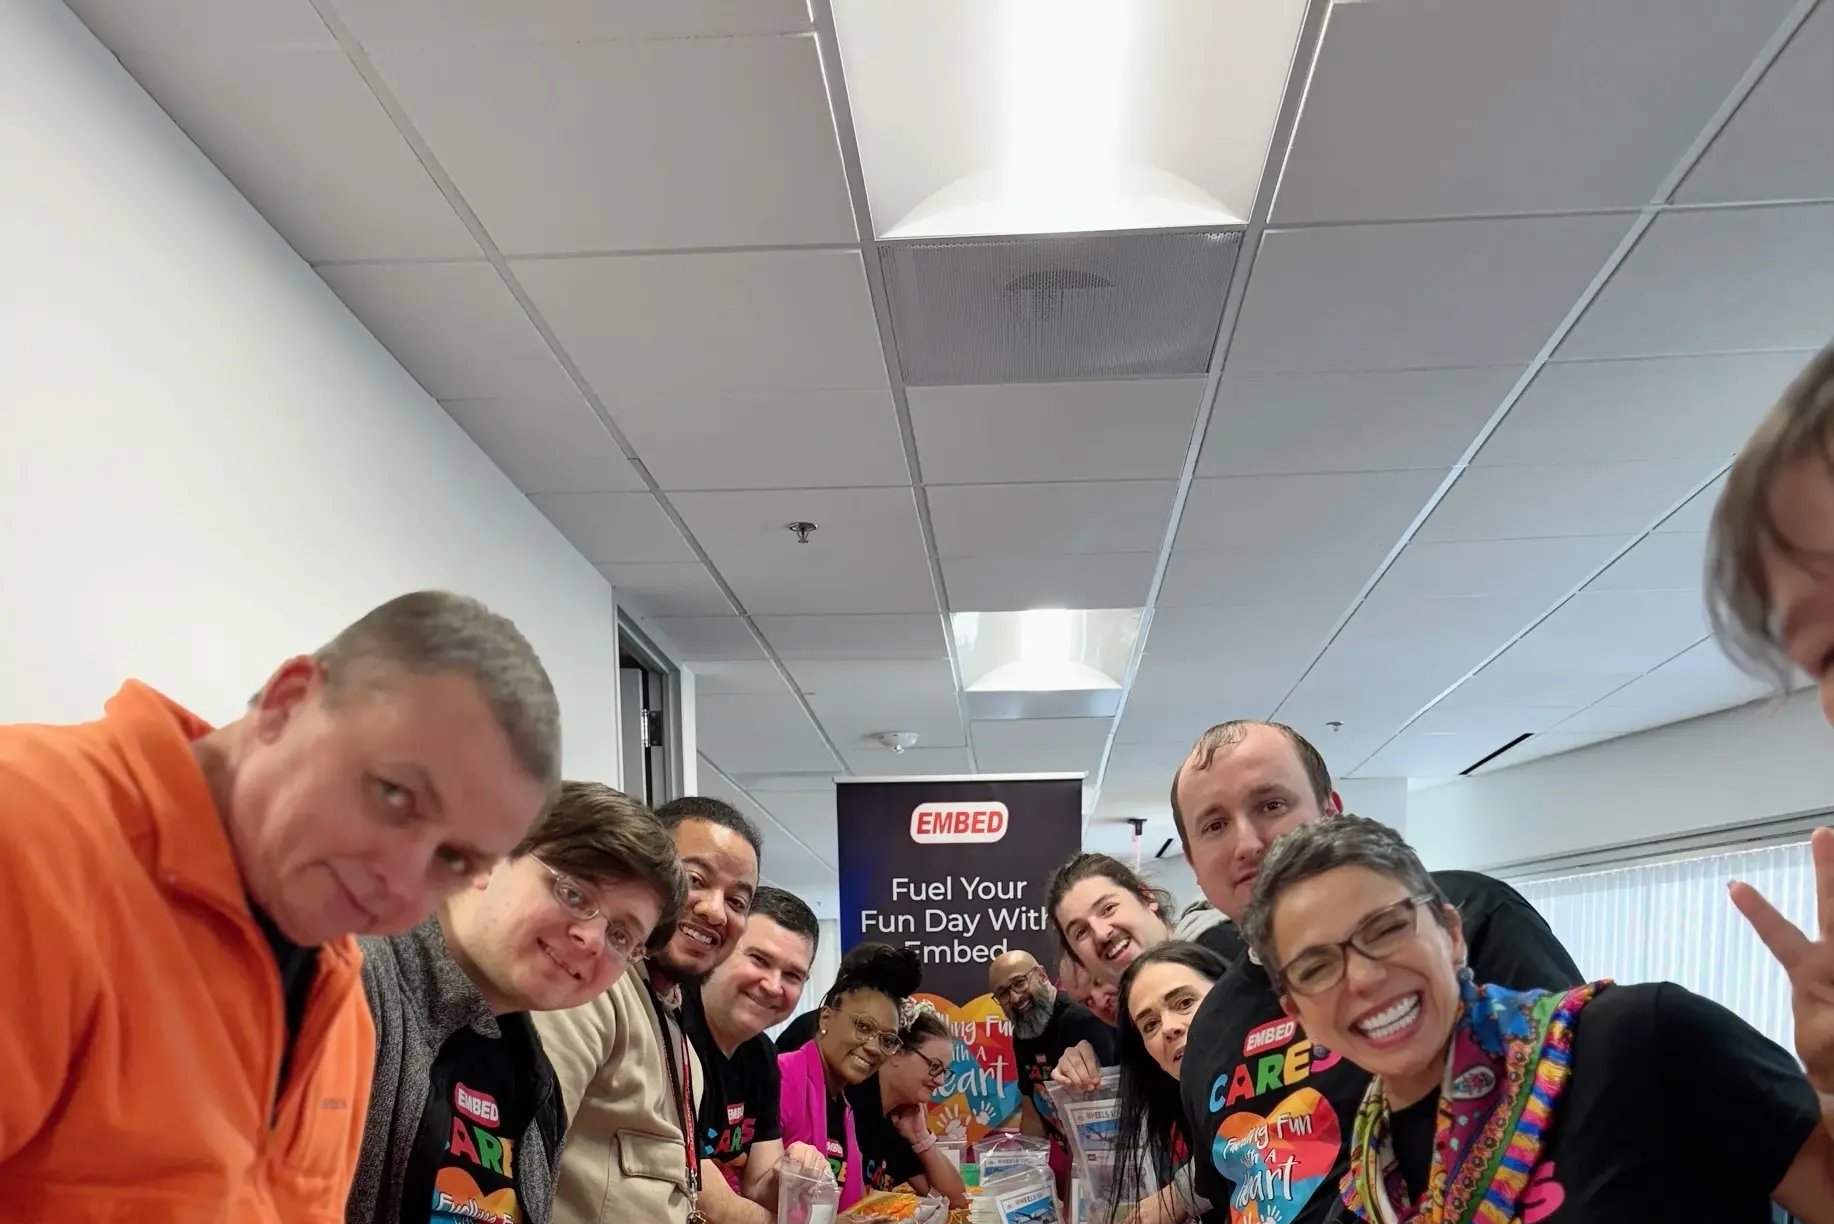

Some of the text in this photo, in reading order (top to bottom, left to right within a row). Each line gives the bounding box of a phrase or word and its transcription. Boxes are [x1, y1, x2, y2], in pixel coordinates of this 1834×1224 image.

[916, 811, 1003, 835] EMBED
[892, 876, 1027, 901] Fuel Your
[861, 910, 915, 933] Fun
[924, 908, 980, 937] Day
[1246, 1021, 1295, 1051] EMBED
[951, 1044, 987, 1062] ith A
[932, 1055, 1009, 1099] eart
[458, 1088, 499, 1121] EMBED
[1277, 1113, 1312, 1139] Fun
[1264, 1148, 1277, 1164] A
